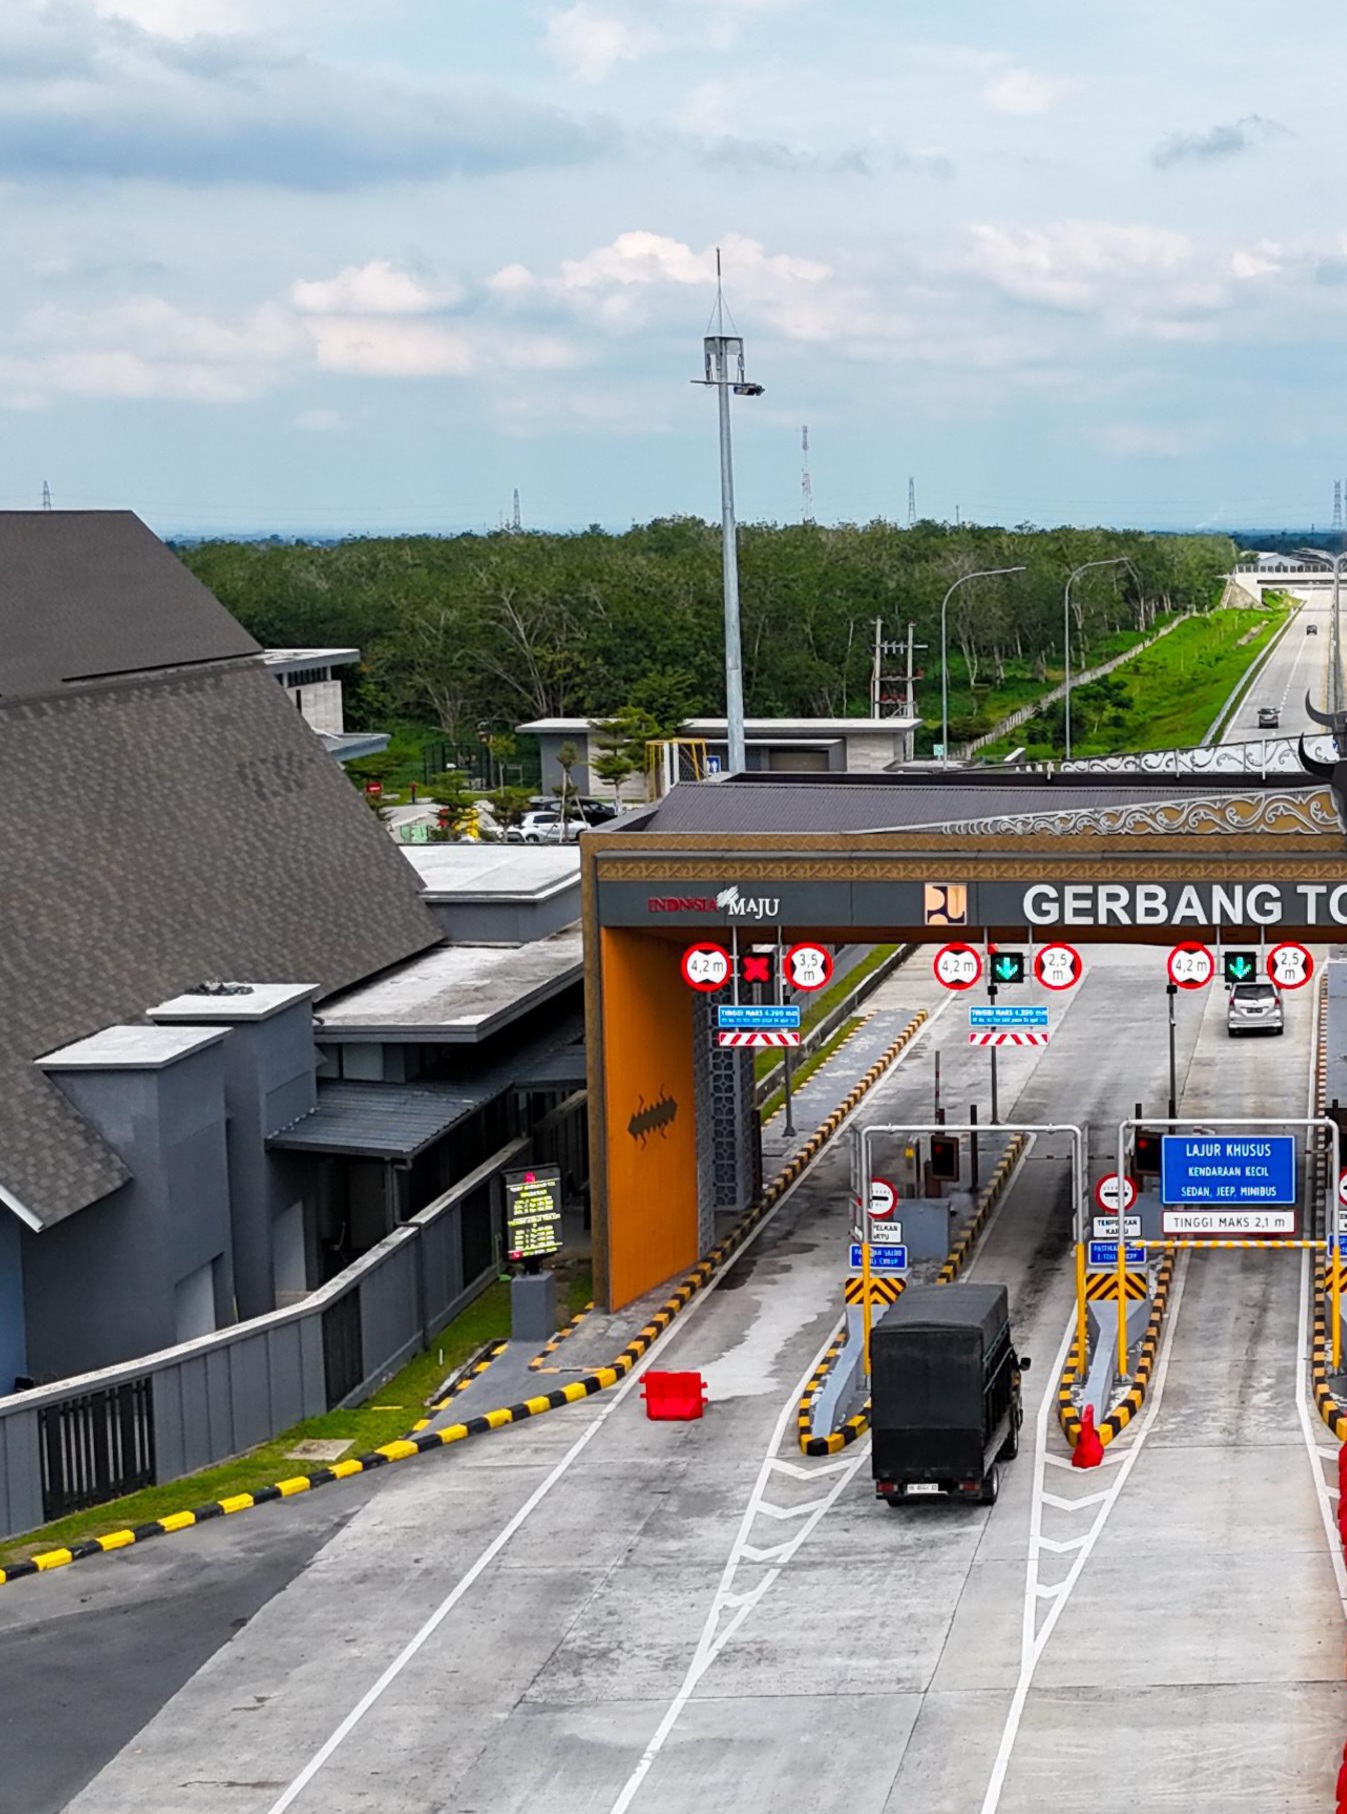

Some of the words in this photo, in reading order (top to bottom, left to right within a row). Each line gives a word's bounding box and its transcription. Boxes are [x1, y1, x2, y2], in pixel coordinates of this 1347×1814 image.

[728, 898, 780, 920] MAJU
[1022, 884, 1283, 926] GERBANG
[690, 959, 710, 974] 4,2
[713, 961, 724, 972] m
[799, 954, 818, 968] 3,5
[941, 959, 960, 974] 4,2
[963, 961, 975, 972] m
[1048, 953, 1067, 967] 2,5
[1175, 959, 1193, 974] 4,2
[1196, 961, 1208, 972] m
[1281, 953, 1300, 966] 2,5
[803, 971, 815, 981] m
[1052, 970, 1064, 981] m
[1284, 970, 1296, 980] m
[1186, 1143, 1221, 1157] LAJUR
[1226, 1143, 1272, 1157] KHUSUS
[1188, 1166, 1241, 1177] KENDARAAN
[1245, 1166, 1269, 1177] KECIL
[1181, 1186, 1212, 1198] SEDAN,
[1216, 1186, 1237, 1198] JEEP,
[1240, 1186, 1277, 1197] MINIBUS
[1174, 1217, 1213, 1228] TINGGI
[1218, 1217, 1250, 1228] MAKS
[1255, 1217, 1269, 1229] 2,1
[1275, 1218, 1285, 1228] m
